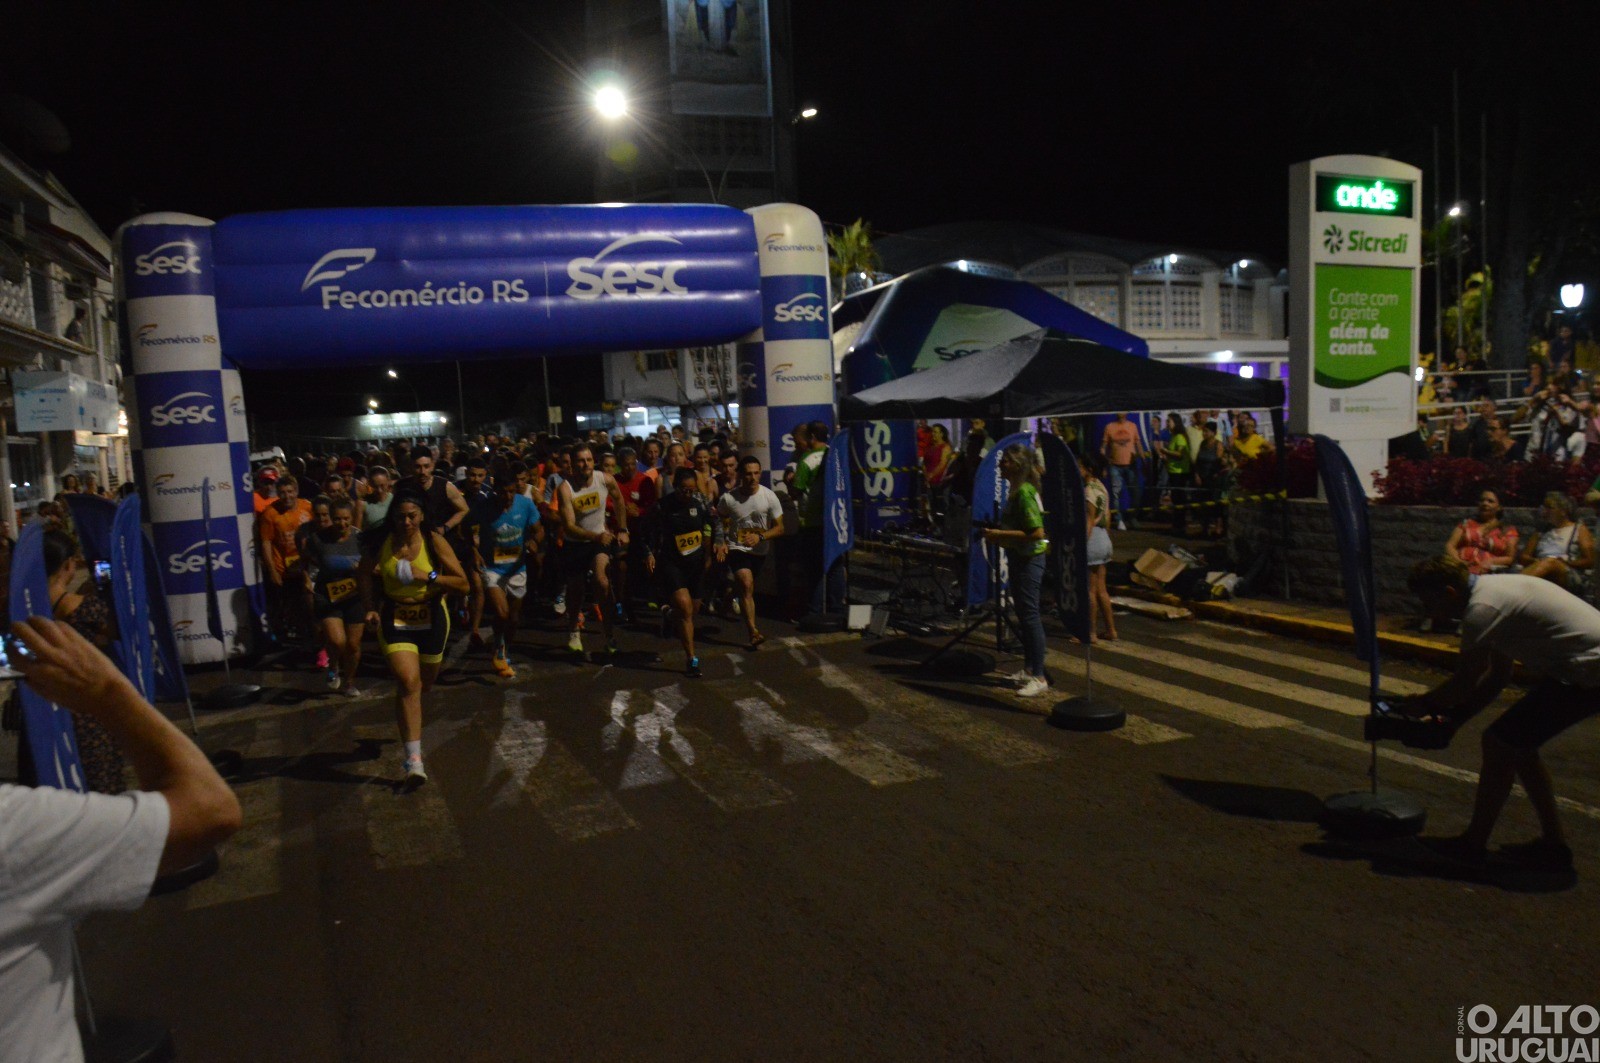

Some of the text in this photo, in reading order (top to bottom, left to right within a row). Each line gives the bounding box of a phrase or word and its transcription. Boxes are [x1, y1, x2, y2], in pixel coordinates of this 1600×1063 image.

[1335, 181, 1399, 211] onde
[1347, 230, 1408, 254] Sicredi
[134, 254, 202, 276] Sesc
[566, 256, 689, 300] Sesc
[321, 279, 529, 310] Fecomércio RS
[1329, 287, 1399, 306] Conte com
[773, 302, 825, 323] Sesc
[1329, 306, 1379, 323] a gente
[1329, 322, 1390, 341] além da
[1329, 340, 1377, 356] conta.
[150, 404, 217, 428] Sesc
[863, 419, 895, 499] Ses
[679, 534, 699, 548] 261
[331, 581, 355, 596] 293
[399, 609, 428, 621] 320
